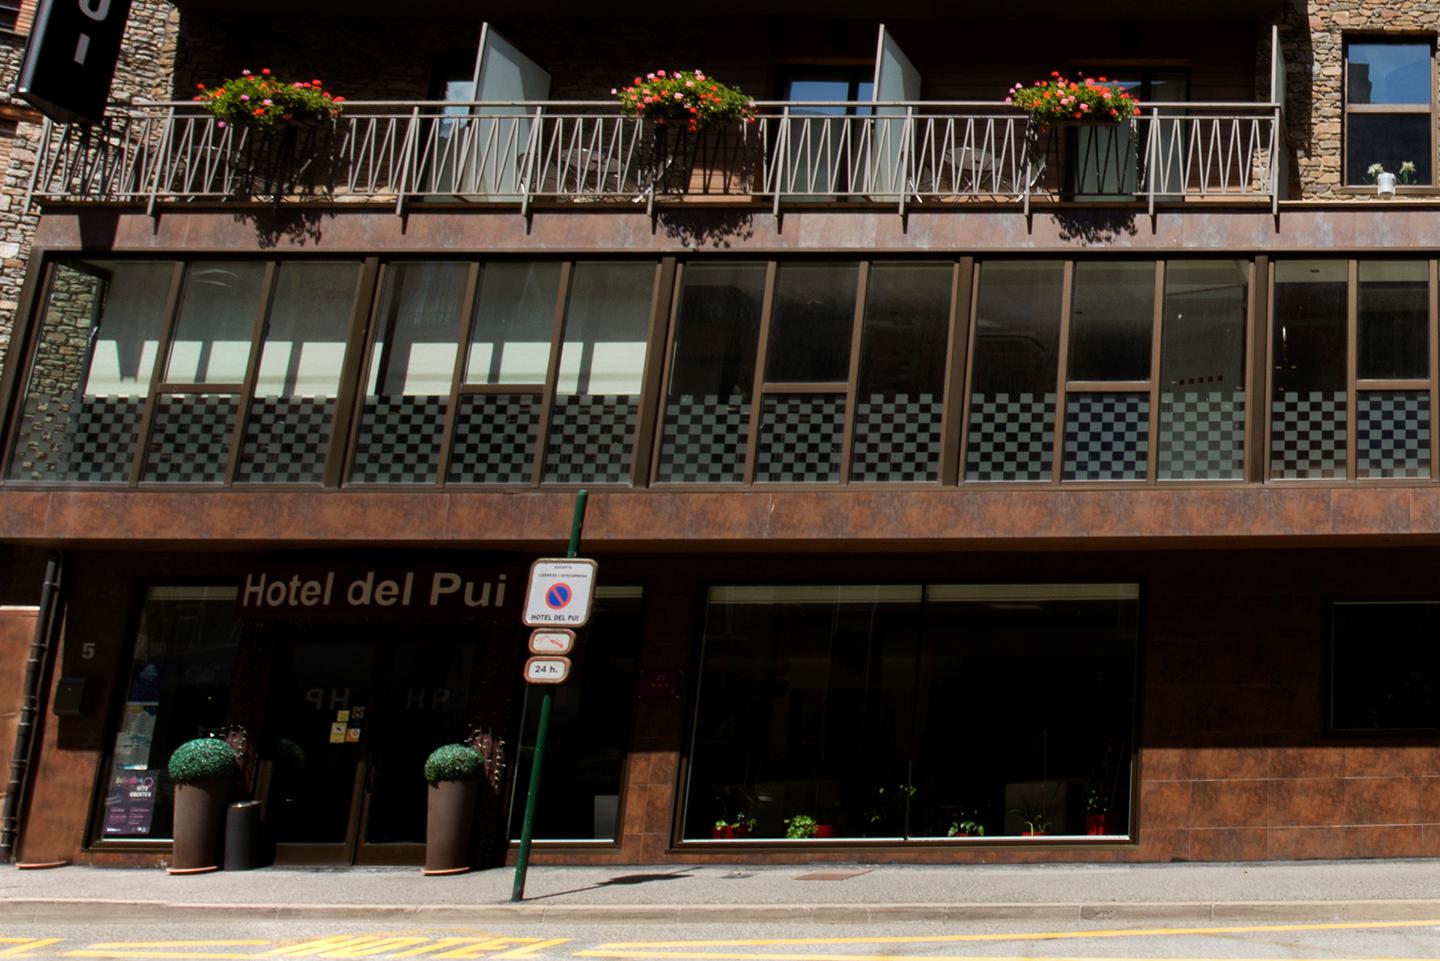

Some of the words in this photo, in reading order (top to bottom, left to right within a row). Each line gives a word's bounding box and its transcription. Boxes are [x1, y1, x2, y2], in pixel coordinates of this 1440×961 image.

[242, 571, 335, 607] Hotel
[346, 571, 414, 606] del
[429, 572, 507, 607] Pui
[81, 643, 95, 659] 5
[535, 665, 547, 673] 24
[405, 687, 450, 712] HP
